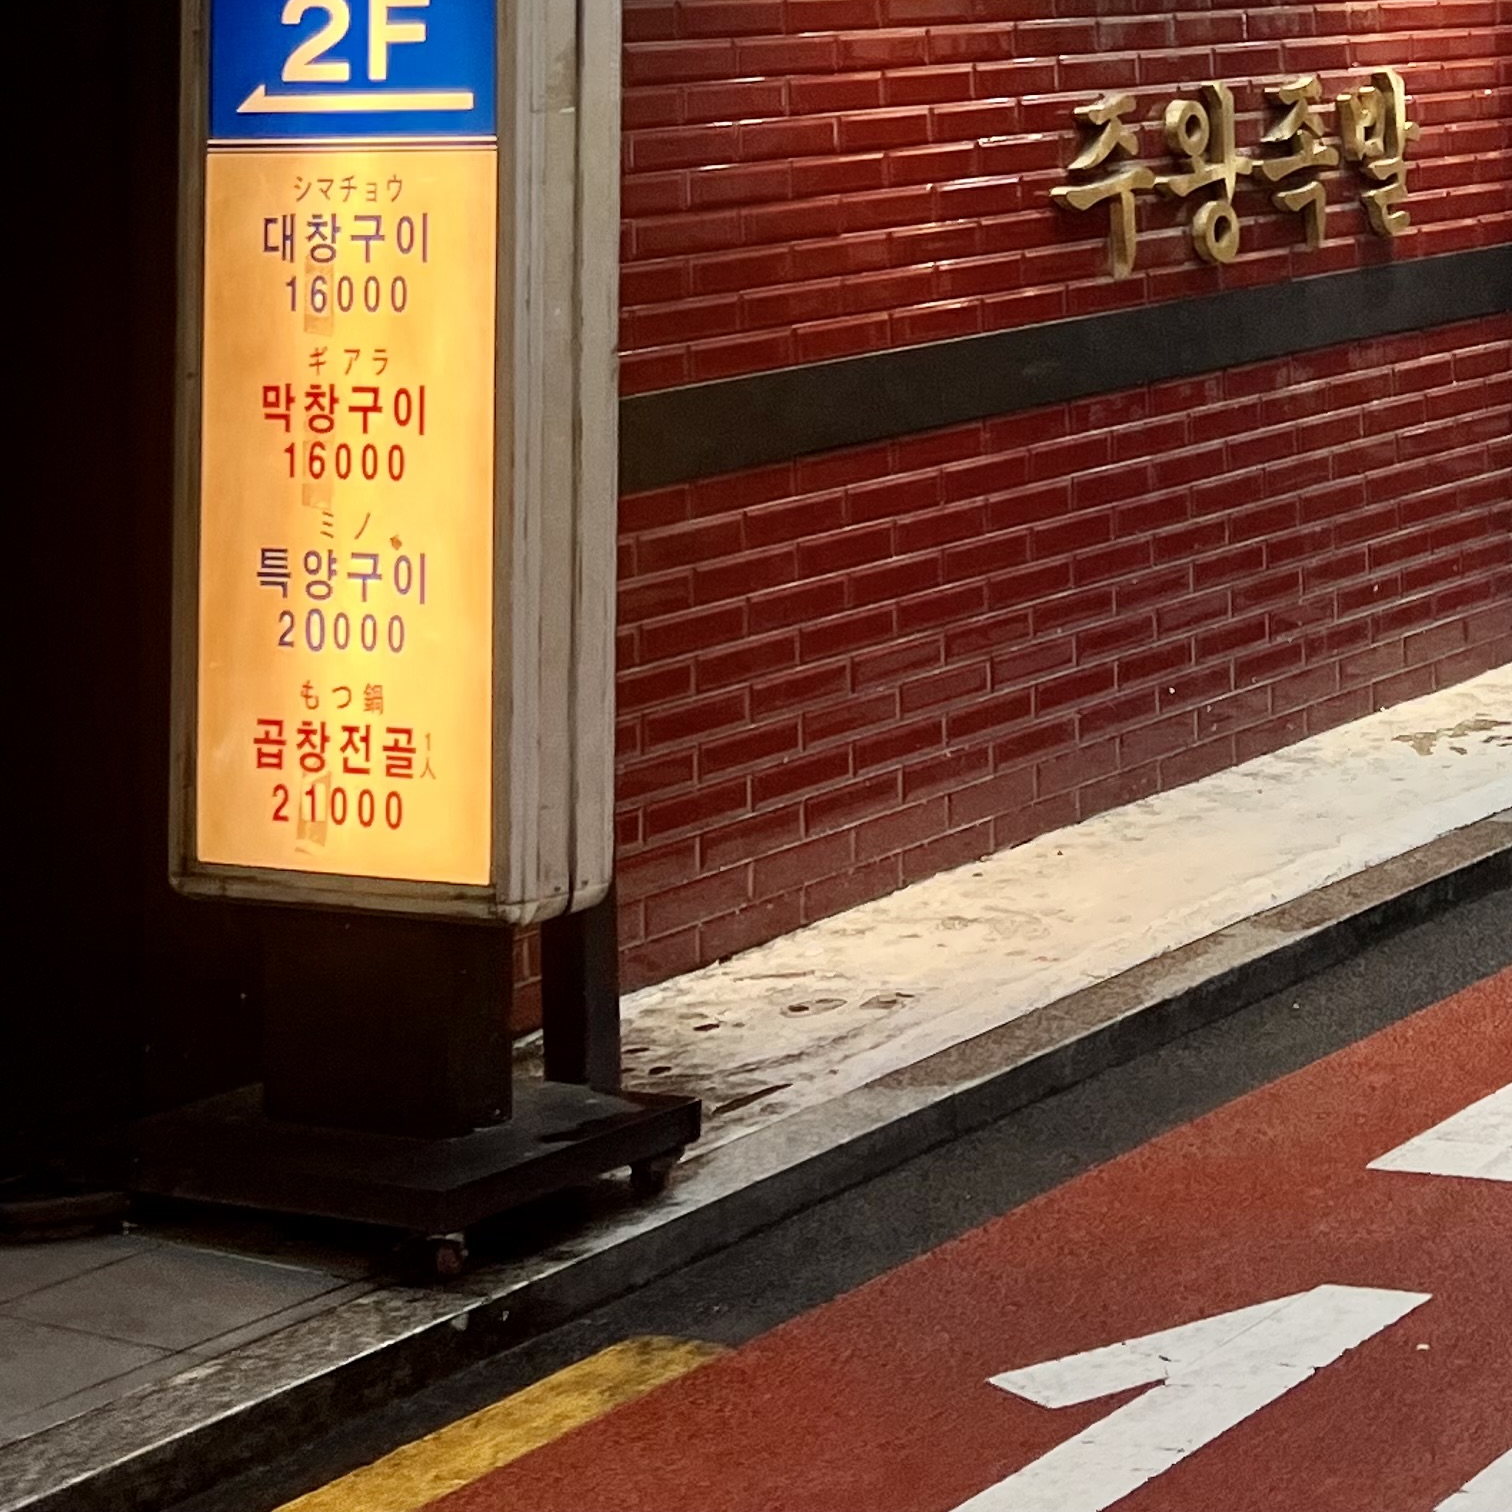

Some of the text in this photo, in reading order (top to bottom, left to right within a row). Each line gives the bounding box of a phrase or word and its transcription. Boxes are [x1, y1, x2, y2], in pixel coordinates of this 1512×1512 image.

[294, 174, 404, 204] シマチョウ
[1050, 66, 1421, 281] 주왕족발
[262, 212, 429, 264] 대창구이
[285, 275, 409, 314] 16000
[308, 346, 390, 377] ギアラ
[261, 384, 426, 435] 막창구이
[283, 441, 406, 481] 16000
[320, 511, 372, 541] ミノ
[256, 547, 427, 605] 특양구이
[277, 608, 406, 653] 20000
[300, 679, 385, 716] もつ鍋
[253, 718, 417, 779] 곱창전골
[271, 782, 405, 831] 21000
